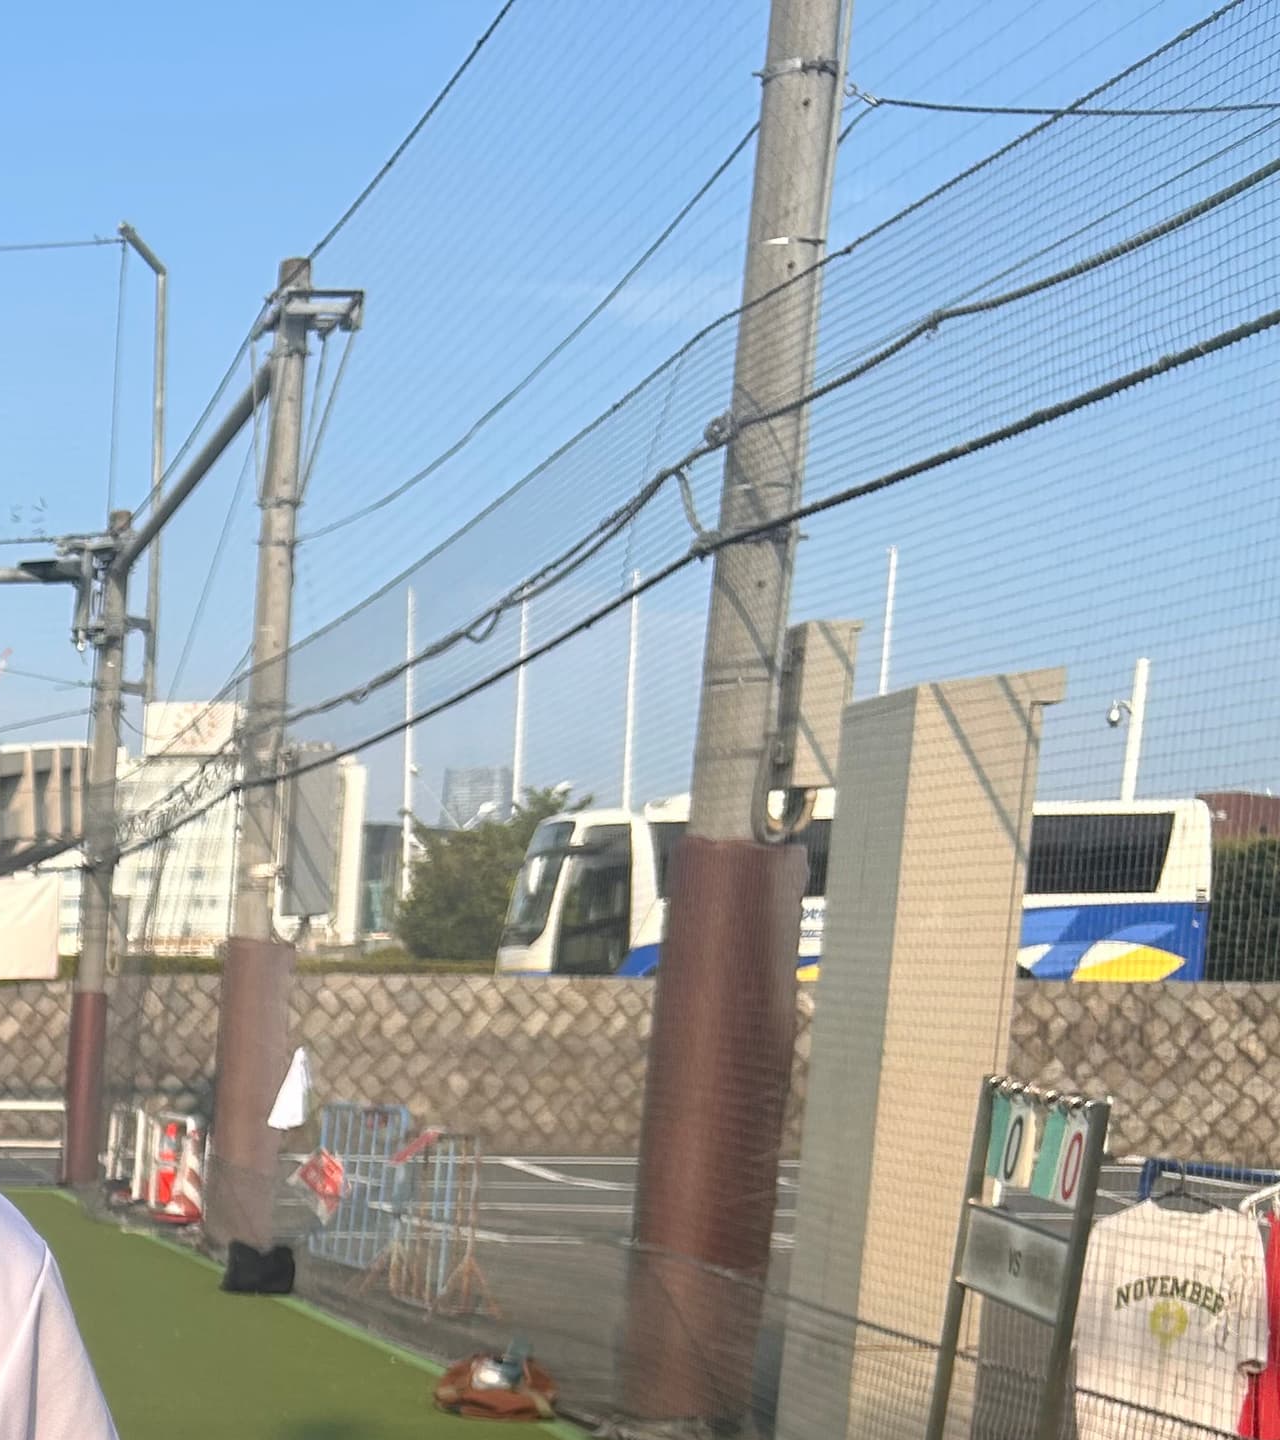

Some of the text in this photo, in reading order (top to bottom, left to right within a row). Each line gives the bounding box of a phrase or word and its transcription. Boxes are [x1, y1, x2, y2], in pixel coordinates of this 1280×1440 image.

[1004, 1115, 1083, 1201] 0 0
[1008, 1248, 1022, 1278] VS
